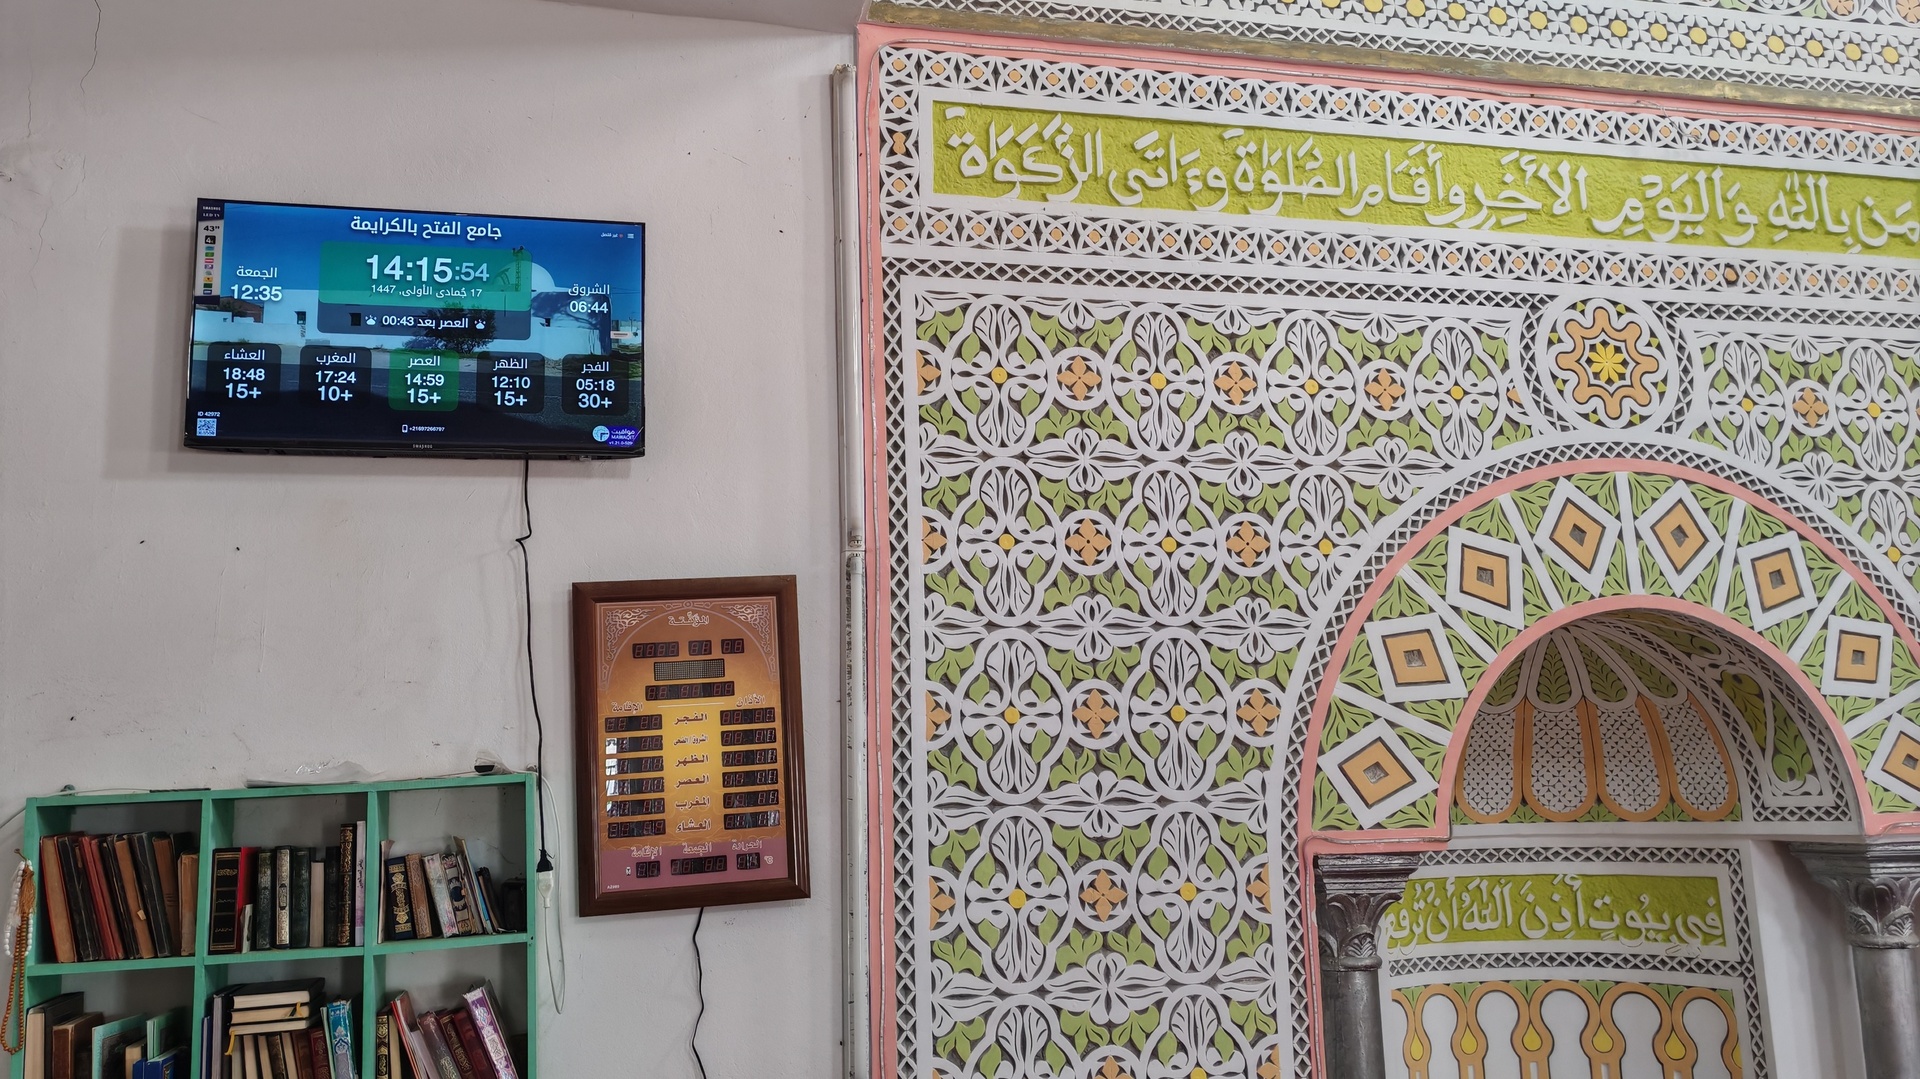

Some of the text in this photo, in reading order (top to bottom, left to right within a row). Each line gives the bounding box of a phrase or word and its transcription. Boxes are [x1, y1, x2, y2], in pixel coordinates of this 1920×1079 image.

[350, 216, 502, 241] جامع الفتح بالكرايمة
[236, 265, 278, 280] الجمعة
[230, 284, 283, 301] 12:35
[371, 284, 396, 294] 1447
[470, 288, 482, 298] 17
[568, 283, 610, 297] الشروق
[569, 300, 608, 314] 06:44
[382, 315, 469, 329] العصر بعد 00:43
[224, 348, 265, 361] العشاء
[316, 352, 356, 365] المغرب
[408, 355, 441, 368] العصر
[493, 357, 528, 371] الظهر
[581, 361, 609, 374] الفجر
[223, 367, 265, 381] 18:48
[315, 370, 357, 384] 17:24
[405, 373, 445, 386] 14:59
[491, 376, 531, 389] 12:10
[576, 378, 615, 391] 05:18
[674, 713, 708, 725] الفجر
[675, 754, 709, 767] الظهر
[674, 774, 710, 788] العصر
[675, 796, 711, 810] المغرب
[675, 818, 712, 833] العشاء
